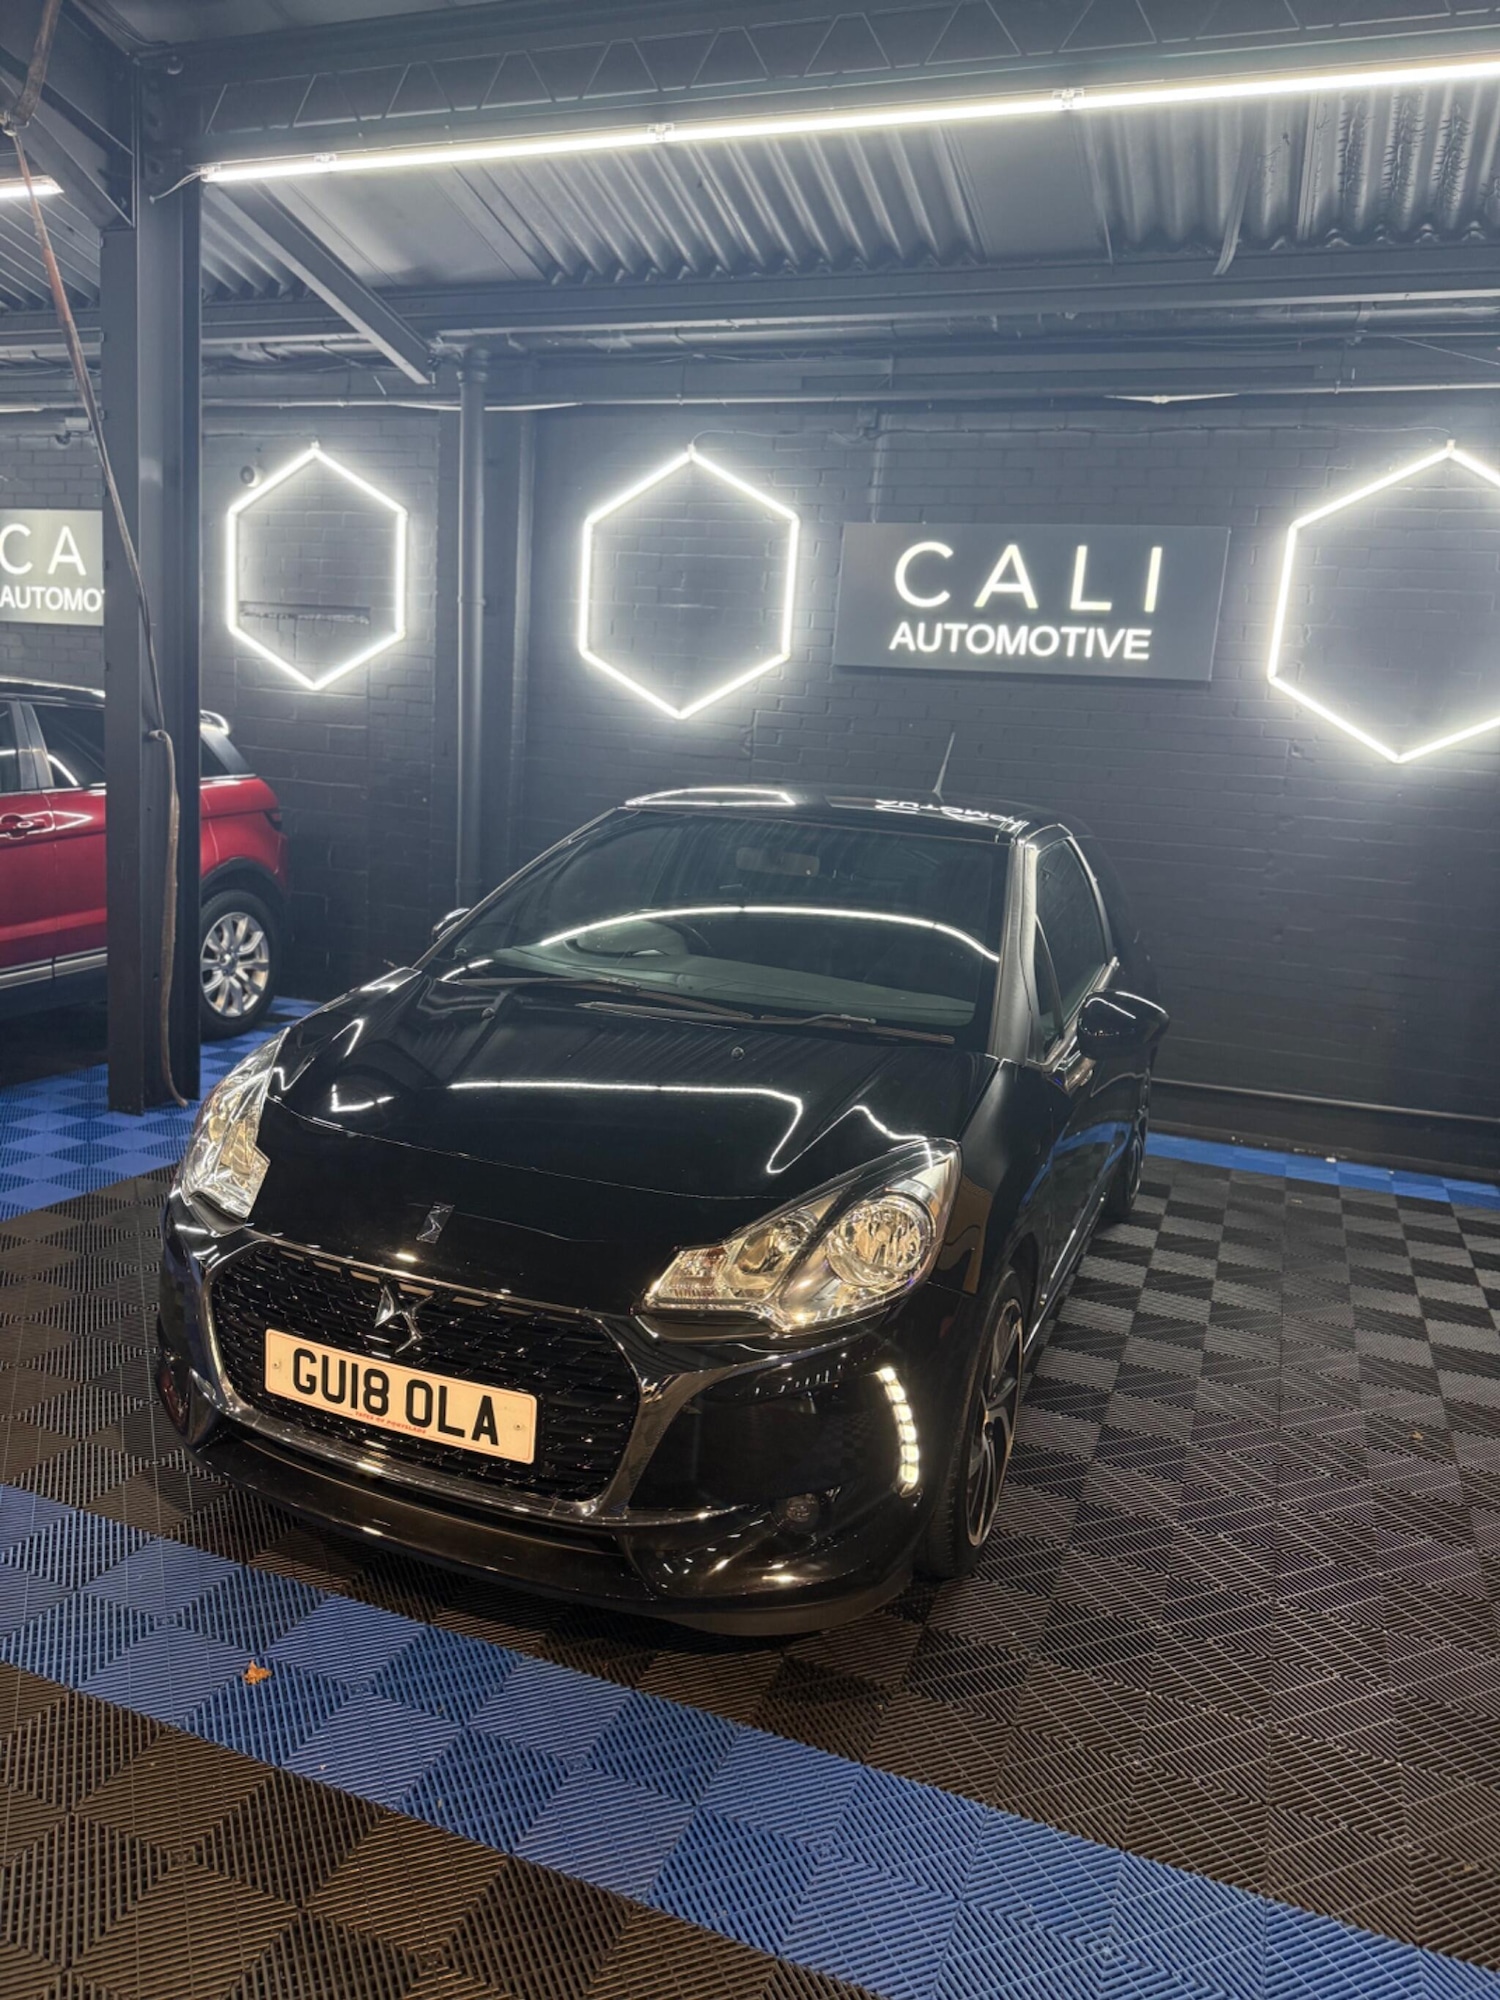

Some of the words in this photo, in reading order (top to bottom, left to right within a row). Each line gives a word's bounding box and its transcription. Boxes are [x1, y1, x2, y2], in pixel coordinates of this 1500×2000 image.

[0, 585, 105, 613] AUTOMO
[894, 541, 1163, 613] CALI
[889, 621, 1153, 661] AUTOMOTIVE
[293, 1347, 390, 1417] GU18
[405, 1379, 499, 1446] OLA
